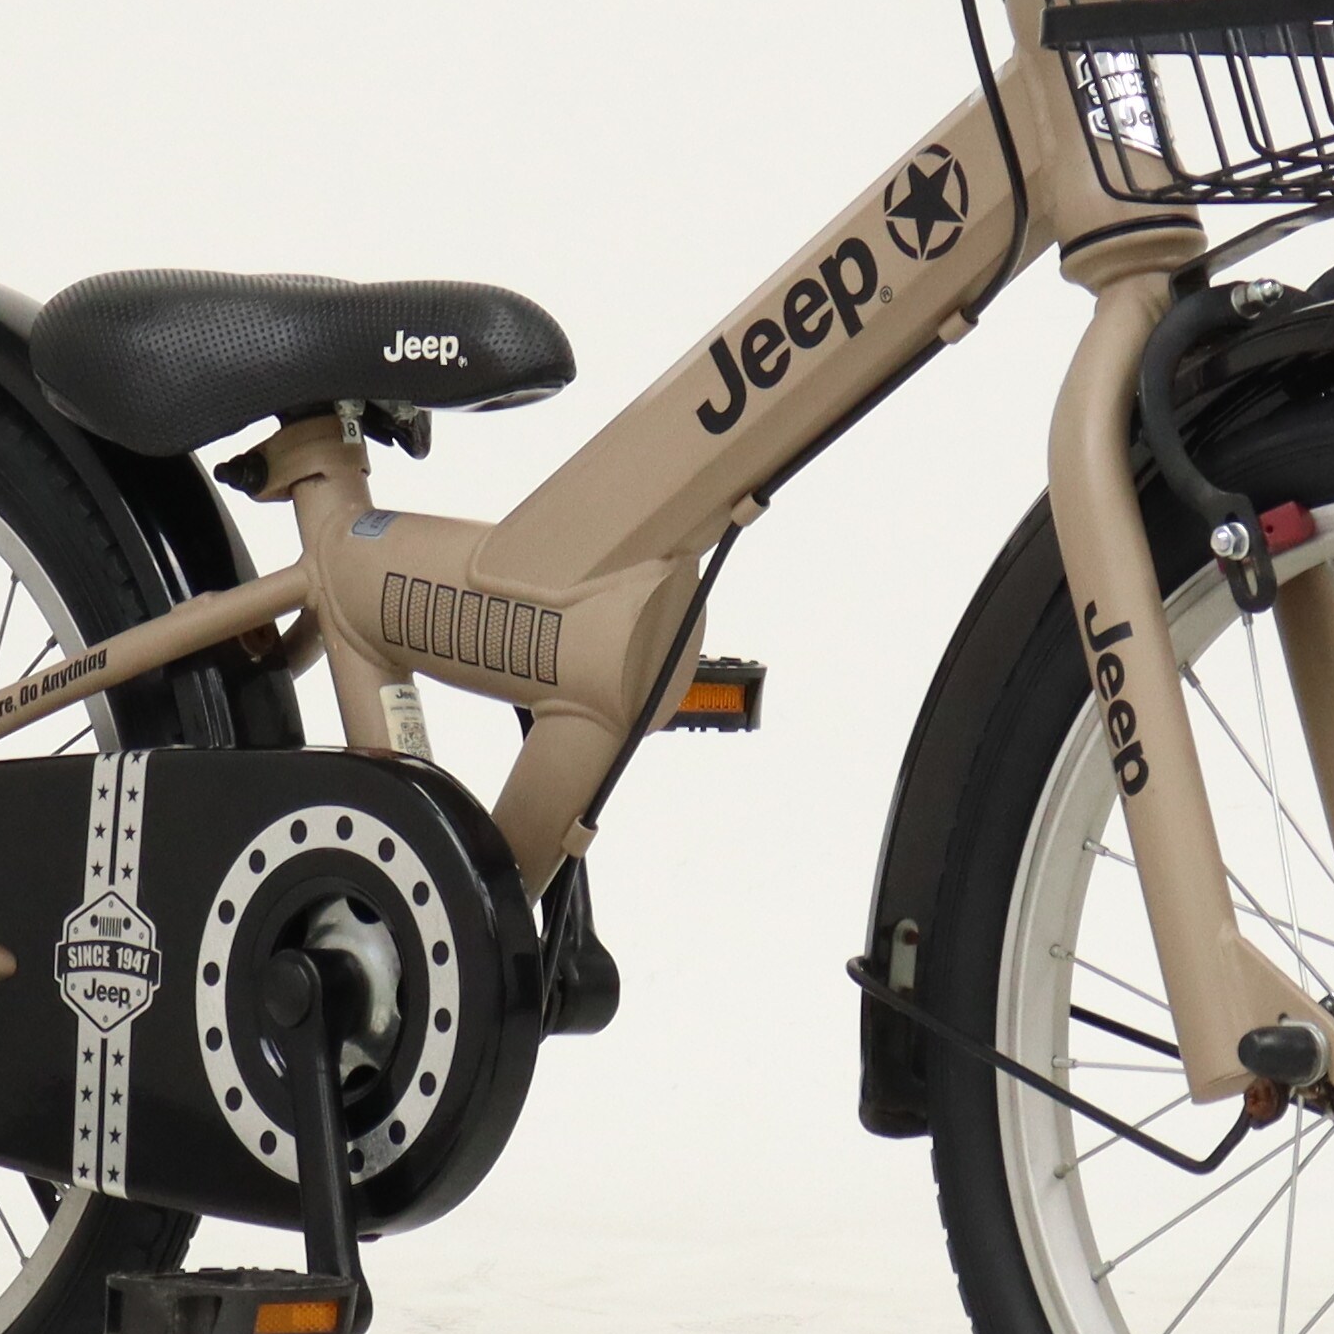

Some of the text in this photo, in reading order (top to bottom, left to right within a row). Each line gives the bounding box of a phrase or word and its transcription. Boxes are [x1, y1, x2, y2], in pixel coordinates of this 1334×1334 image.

[383, 329, 459, 366] Jeep
[696, 237, 878, 435] Jeep
[19, 685, 38, 706] Do
[41, 648, 108, 696] Anything
[1083, 599, 1149, 797] Jeep
[67, 944, 151, 975] SINCE 1941
[83, 977, 131, 1009] Jeep
